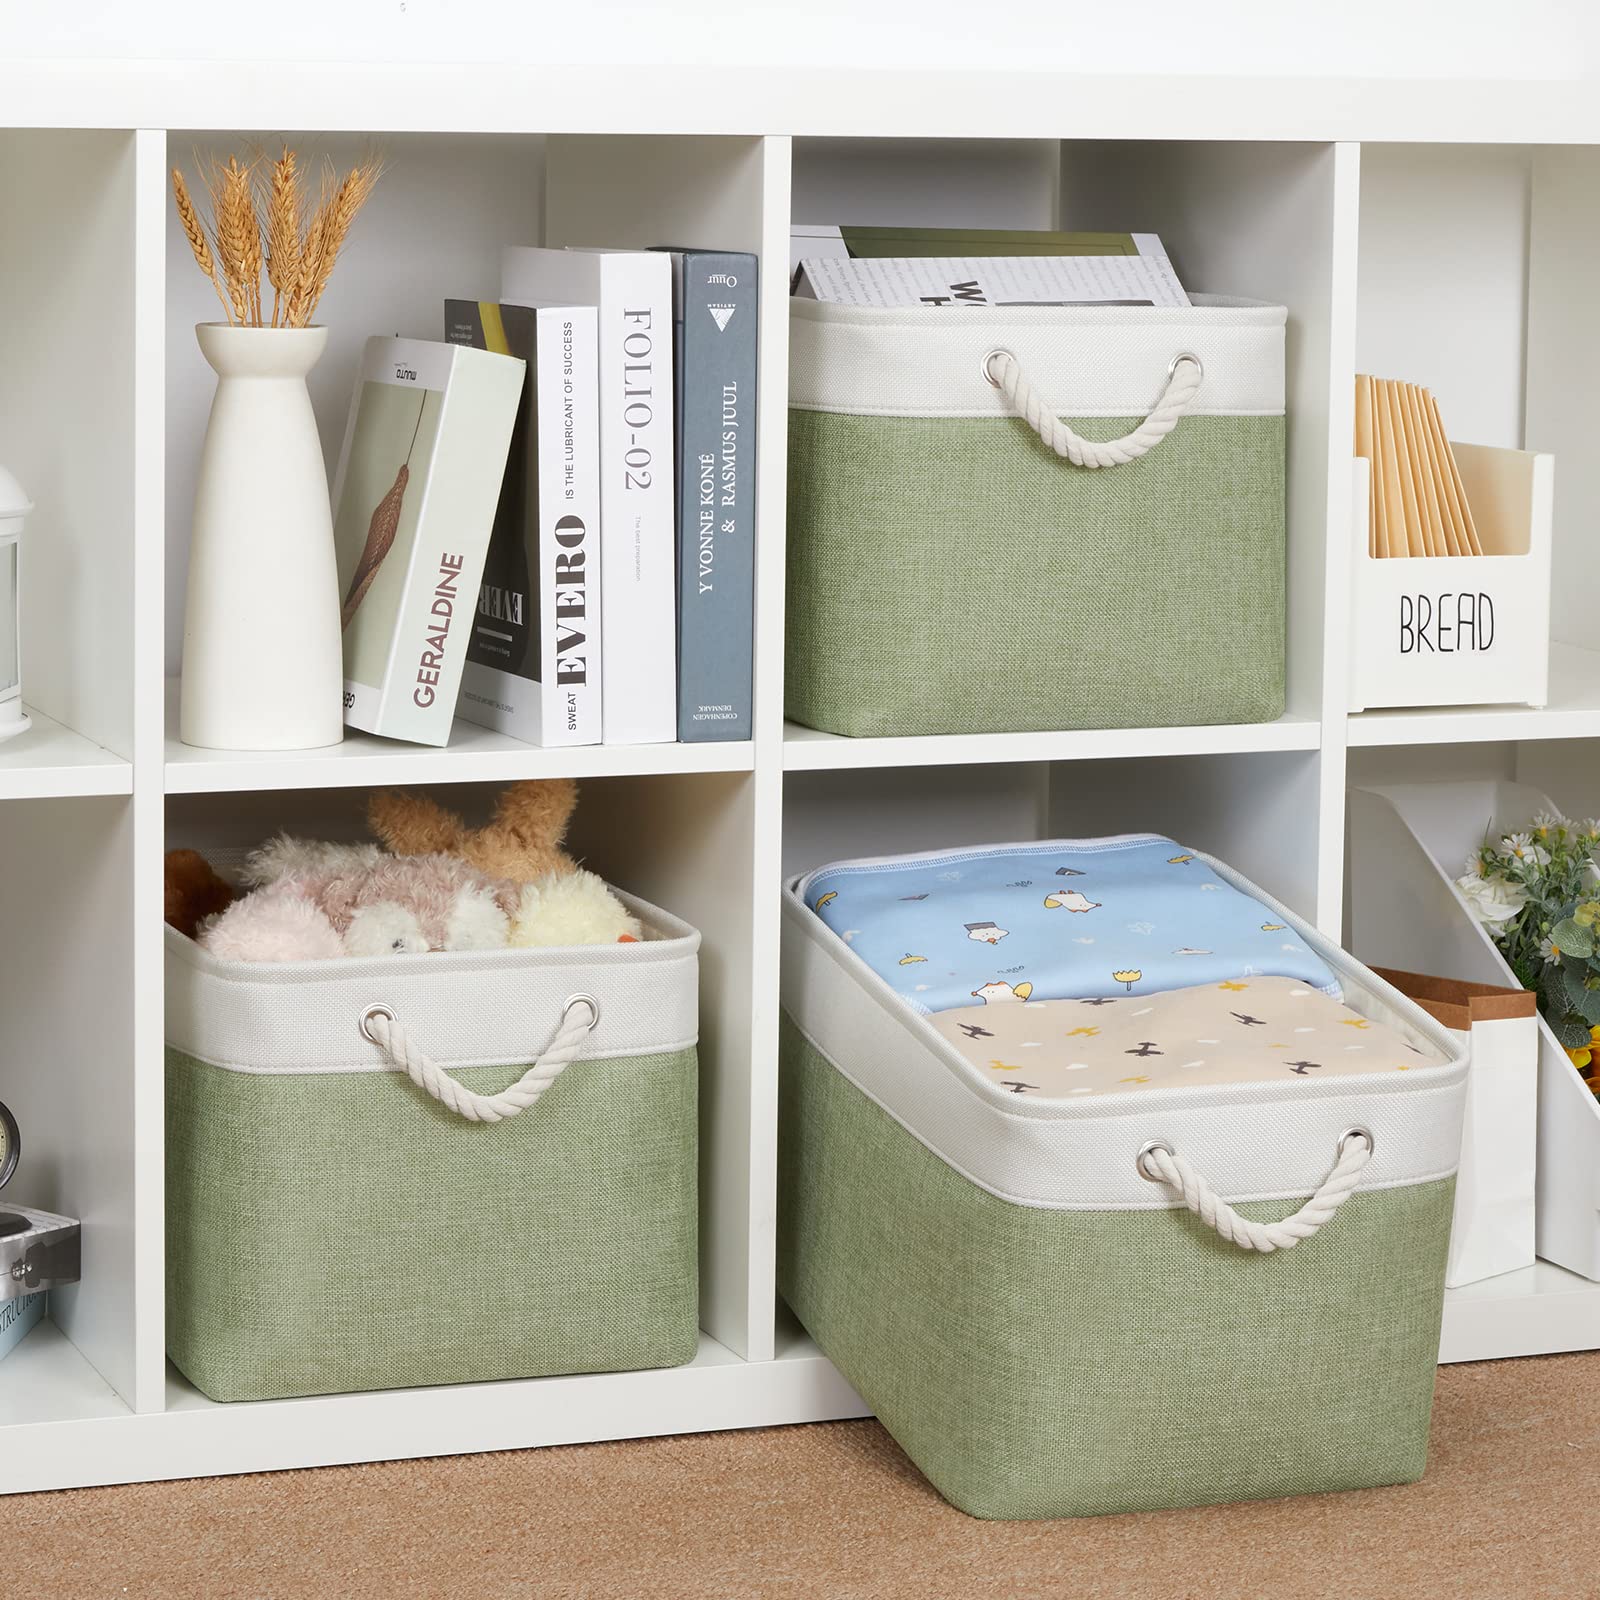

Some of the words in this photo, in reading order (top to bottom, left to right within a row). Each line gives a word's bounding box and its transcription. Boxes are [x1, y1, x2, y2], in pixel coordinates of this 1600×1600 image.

[563, 321, 573, 376] SUCCESS
[563, 378, 573, 394] OF
[623, 307, 653, 491] FOLIO-02
[722, 380, 739, 428] JUUL
[564, 396, 574, 461] LUBRICANT
[565, 463, 574, 487] THE
[565, 488, 574, 500] IS
[698, 453, 715, 506] KONÉ
[721, 431, 737, 507] RASMUS
[720, 518, 736, 534] &
[554, 514, 587, 689] EVERO
[1399, 591, 1495, 654] BREAD
[412, 552, 465, 708] GERALDINE
[567, 691, 578, 731] SWEAT
[692, 712, 738, 721] COPENHAGEN
[698, 704, 732, 713] DENMARK
